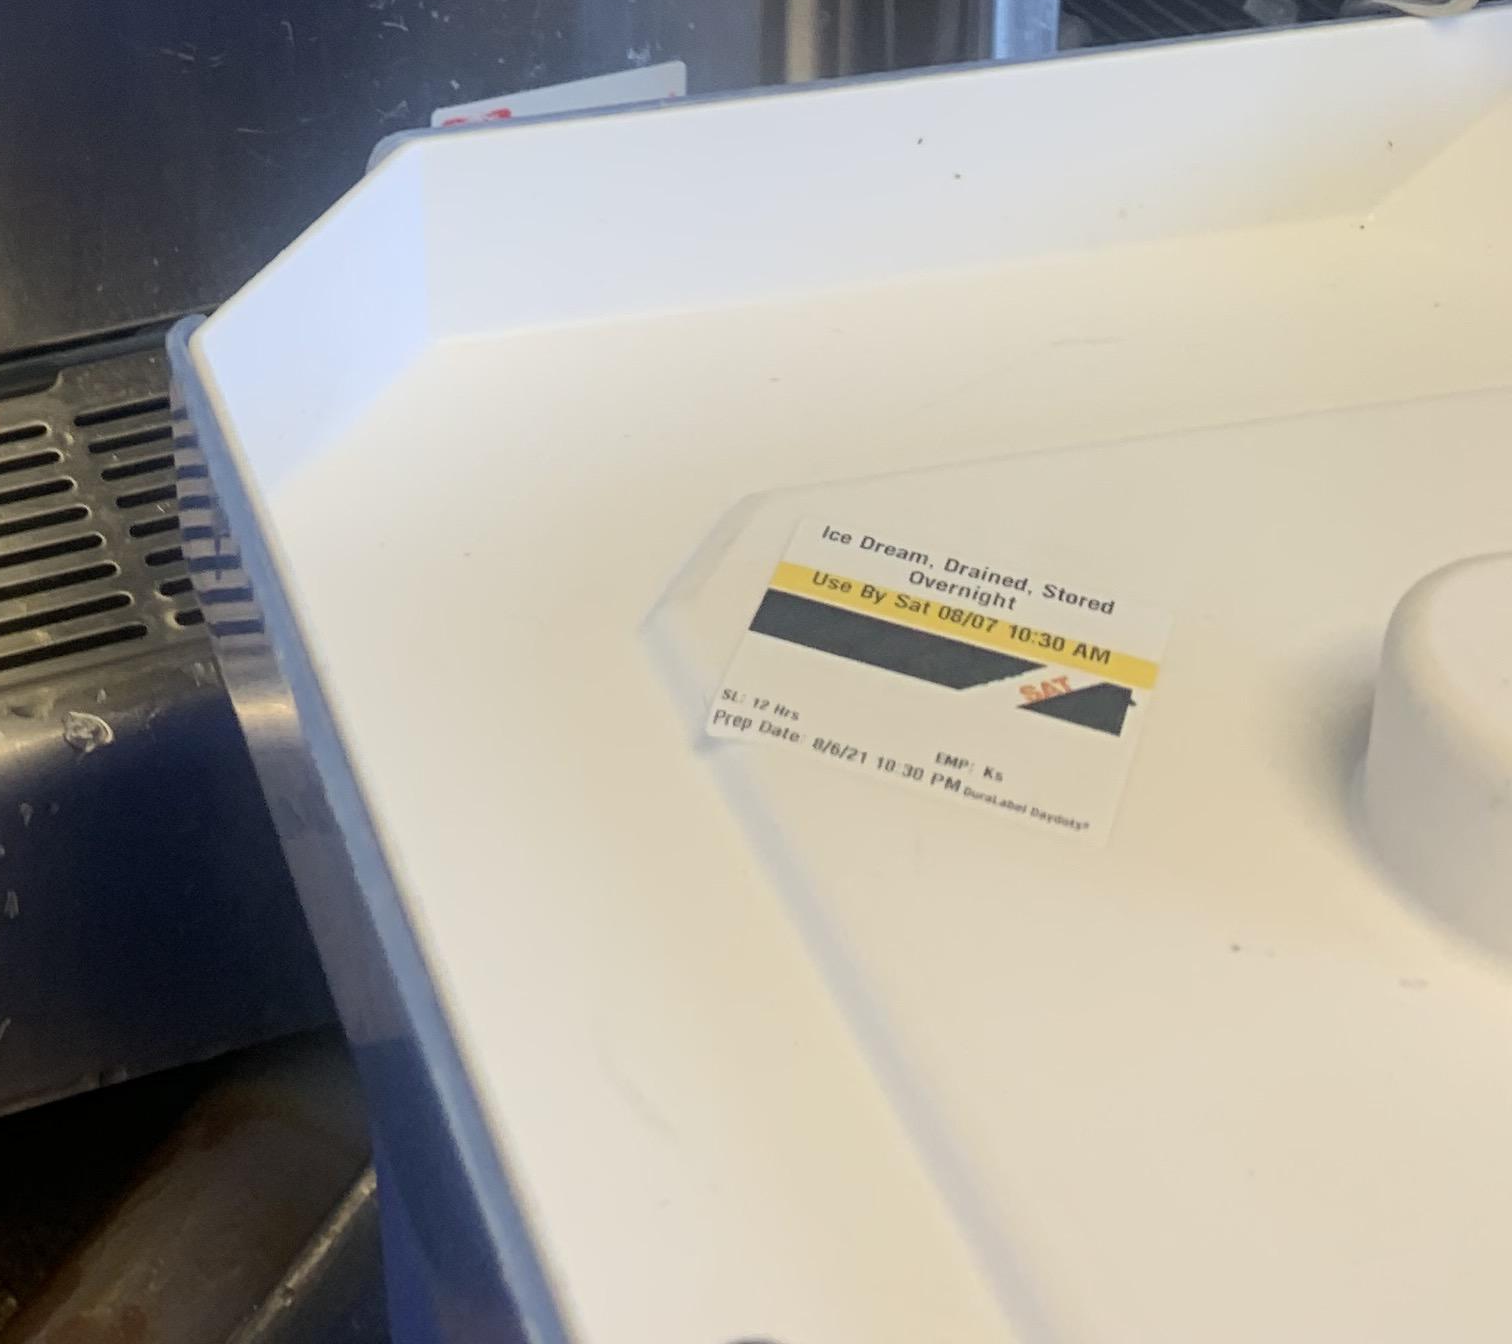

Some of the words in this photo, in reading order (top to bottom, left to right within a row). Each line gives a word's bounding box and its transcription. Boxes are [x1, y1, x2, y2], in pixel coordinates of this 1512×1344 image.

[821, 524, 853, 546] Ice
[944, 557, 1033, 596] Drained,
[1041, 584, 1115, 615] Stored
[908, 570, 1018, 611] Overnight
[811, 570, 853, 594] Use
[860, 584, 887, 605] By
[894, 593, 932, 616] Sat
[938, 605, 999, 634] 08/07
[1009, 624, 1066, 652] 10:30
[1072, 640, 1112, 665] AM
[752, 697, 771, 711] 12
[773, 703, 800, 722] Hrs
[1018, 675, 1075, 704] SAT
[712, 709, 753, 732] Prep
[811, 736, 868, 765] 8/6/21
[930, 772, 962, 793] PM
